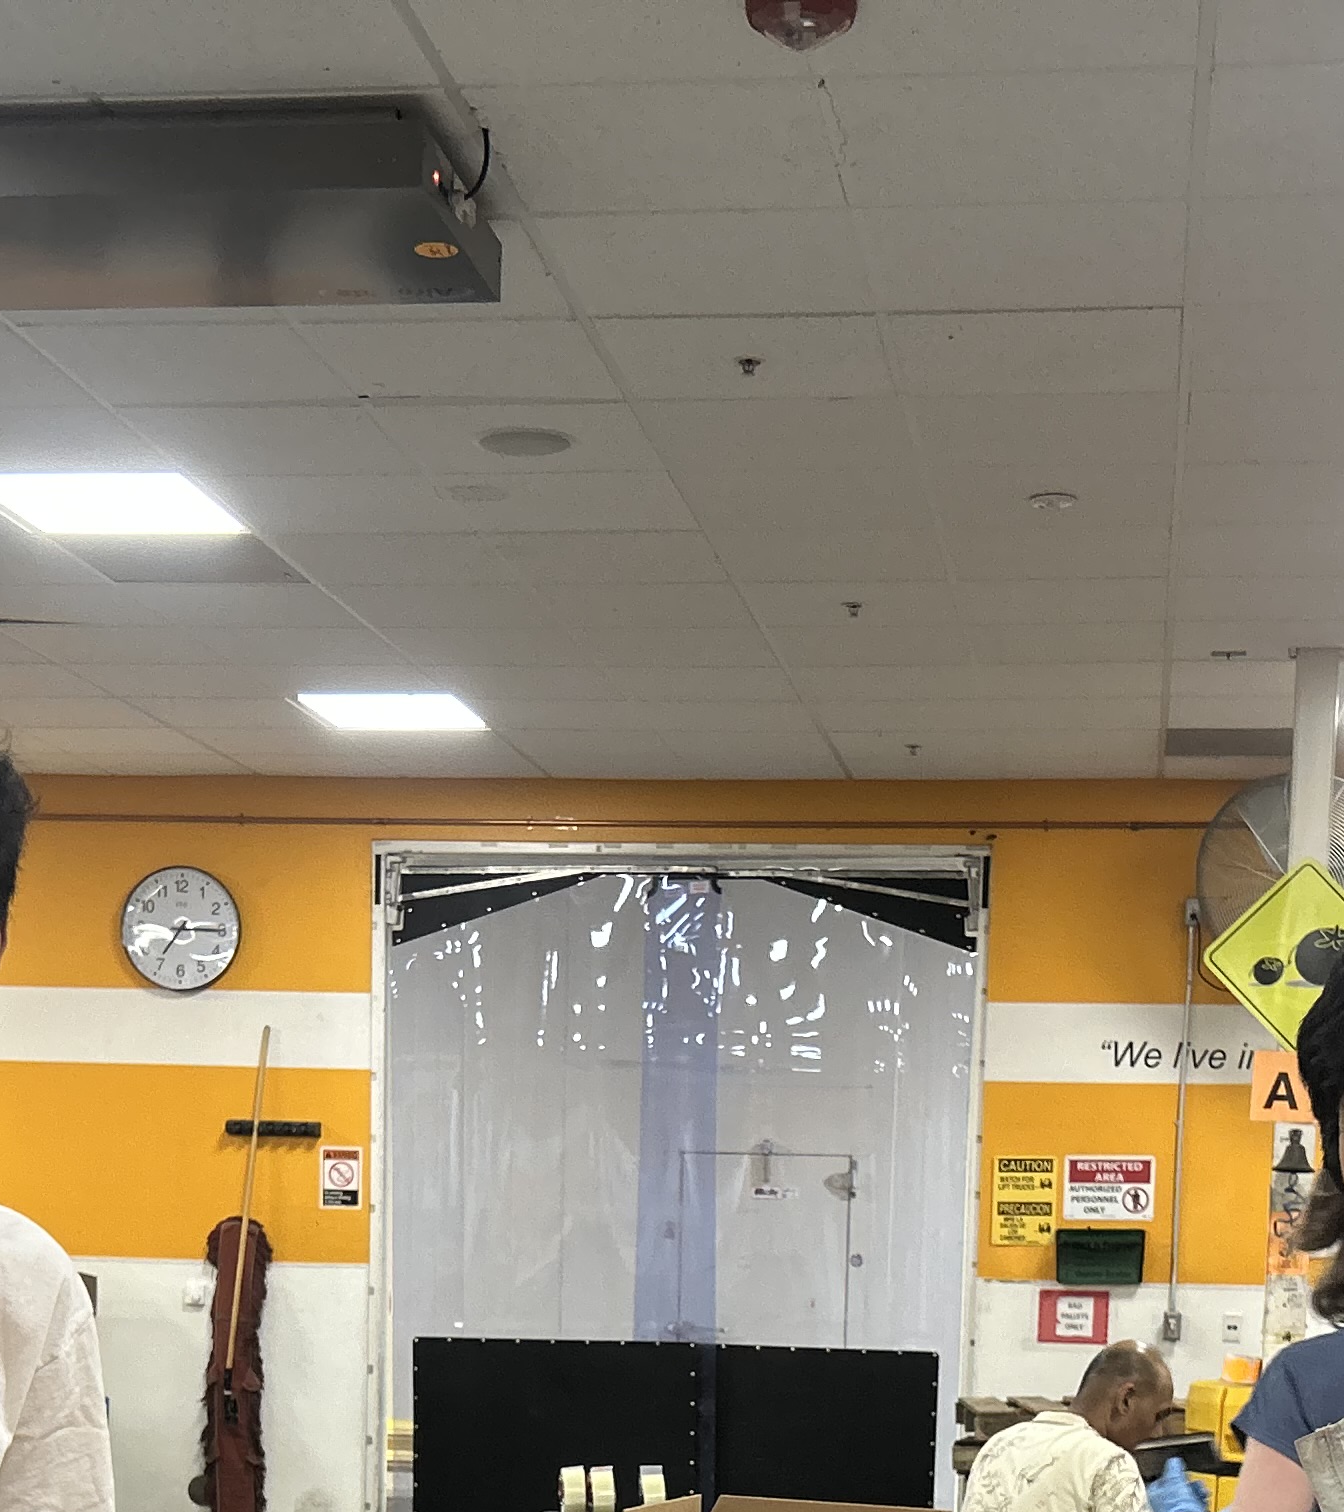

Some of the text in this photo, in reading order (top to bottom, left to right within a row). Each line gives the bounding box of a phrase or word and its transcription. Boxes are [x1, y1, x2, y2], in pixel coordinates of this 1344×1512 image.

[157, 886, 168, 898] 11
[175, 880, 189, 893] 12
[200, 886, 205, 899] 1
[141, 900, 155, 913] 10
[211, 902, 221, 915] 2
[218, 923, 227, 937] 3
[211, 944, 220, 955] 4
[156, 958, 165, 971] 7
[176, 964, 185, 977] 6
[197, 960, 206, 973] 5
[1000, 1160, 1052, 1172] CAUTION
[1077, 1162, 1144, 1172] RESTRICTED
[1094, 1173, 1125, 1183] AREA
[1069, 1185, 1123, 1193] AUTHORIZED
[1071, 1196, 1119, 1204] PERSONNEL
[1084, 1206, 1106, 1215] ONLY
